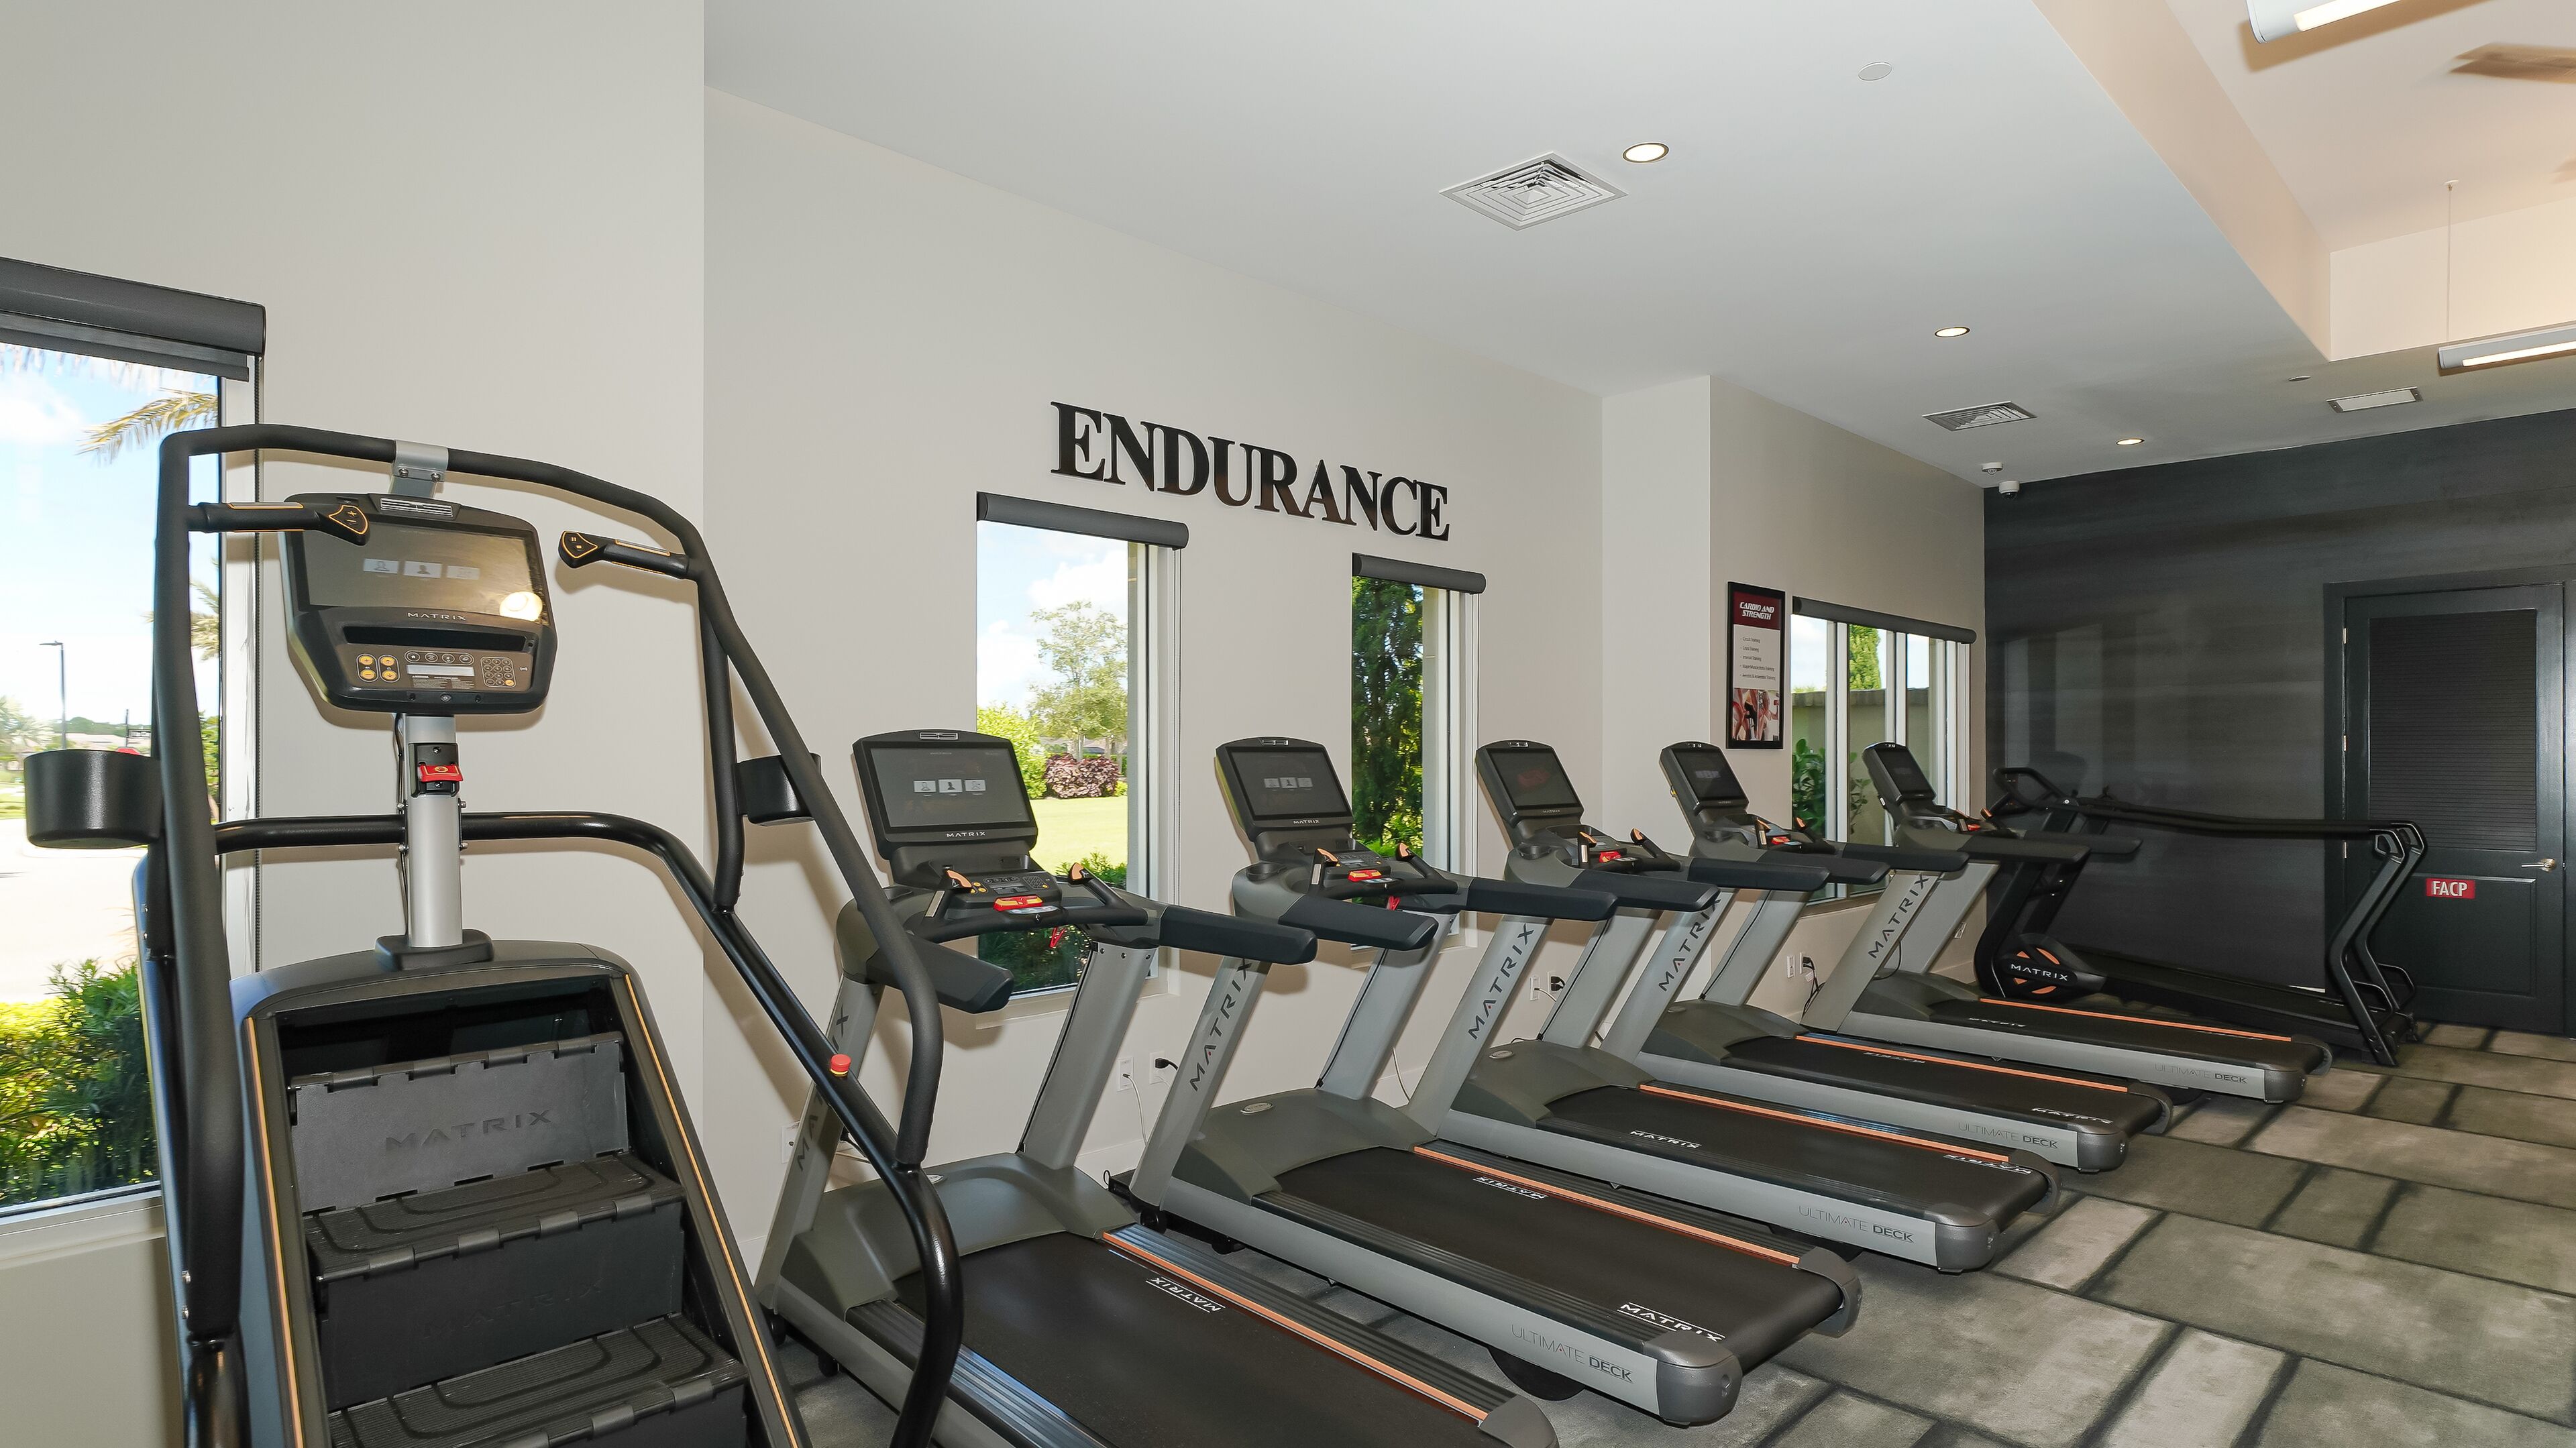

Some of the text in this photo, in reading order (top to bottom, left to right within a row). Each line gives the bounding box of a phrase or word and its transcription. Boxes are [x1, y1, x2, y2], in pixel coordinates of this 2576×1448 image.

[1051, 401, 1450, 541] ENDURANCE
[407, 612, 466, 621] MATRIX
[1739, 602, 1761, 611] CARDIO
[1742, 610, 1771, 620] STRENGTH
[2432, 880, 2468, 897] FACP
[1868, 873, 1929, 959] MATRIX
[1468, 922, 1534, 1040] MATRIX
[2010, 964, 2068, 981] MATRIX
[1189, 958, 1252, 1092] MATRIX
[2154, 1062, 2248, 1084] ULTIMATE DECK
[386, 1109, 552, 1152] MATRIX
[1629, 1130, 1700, 1149] MATRIX
[1957, 1121, 2058, 1150] ULTIMATE DECK
[1797, 1205, 1915, 1243] ULTIMATE DECK
[1150, 1277, 1222, 1312] MATRIX
[1620, 1303, 1723, 1343] MATRIX
[1511, 1323, 1633, 1384] ULTIMATE DECK
